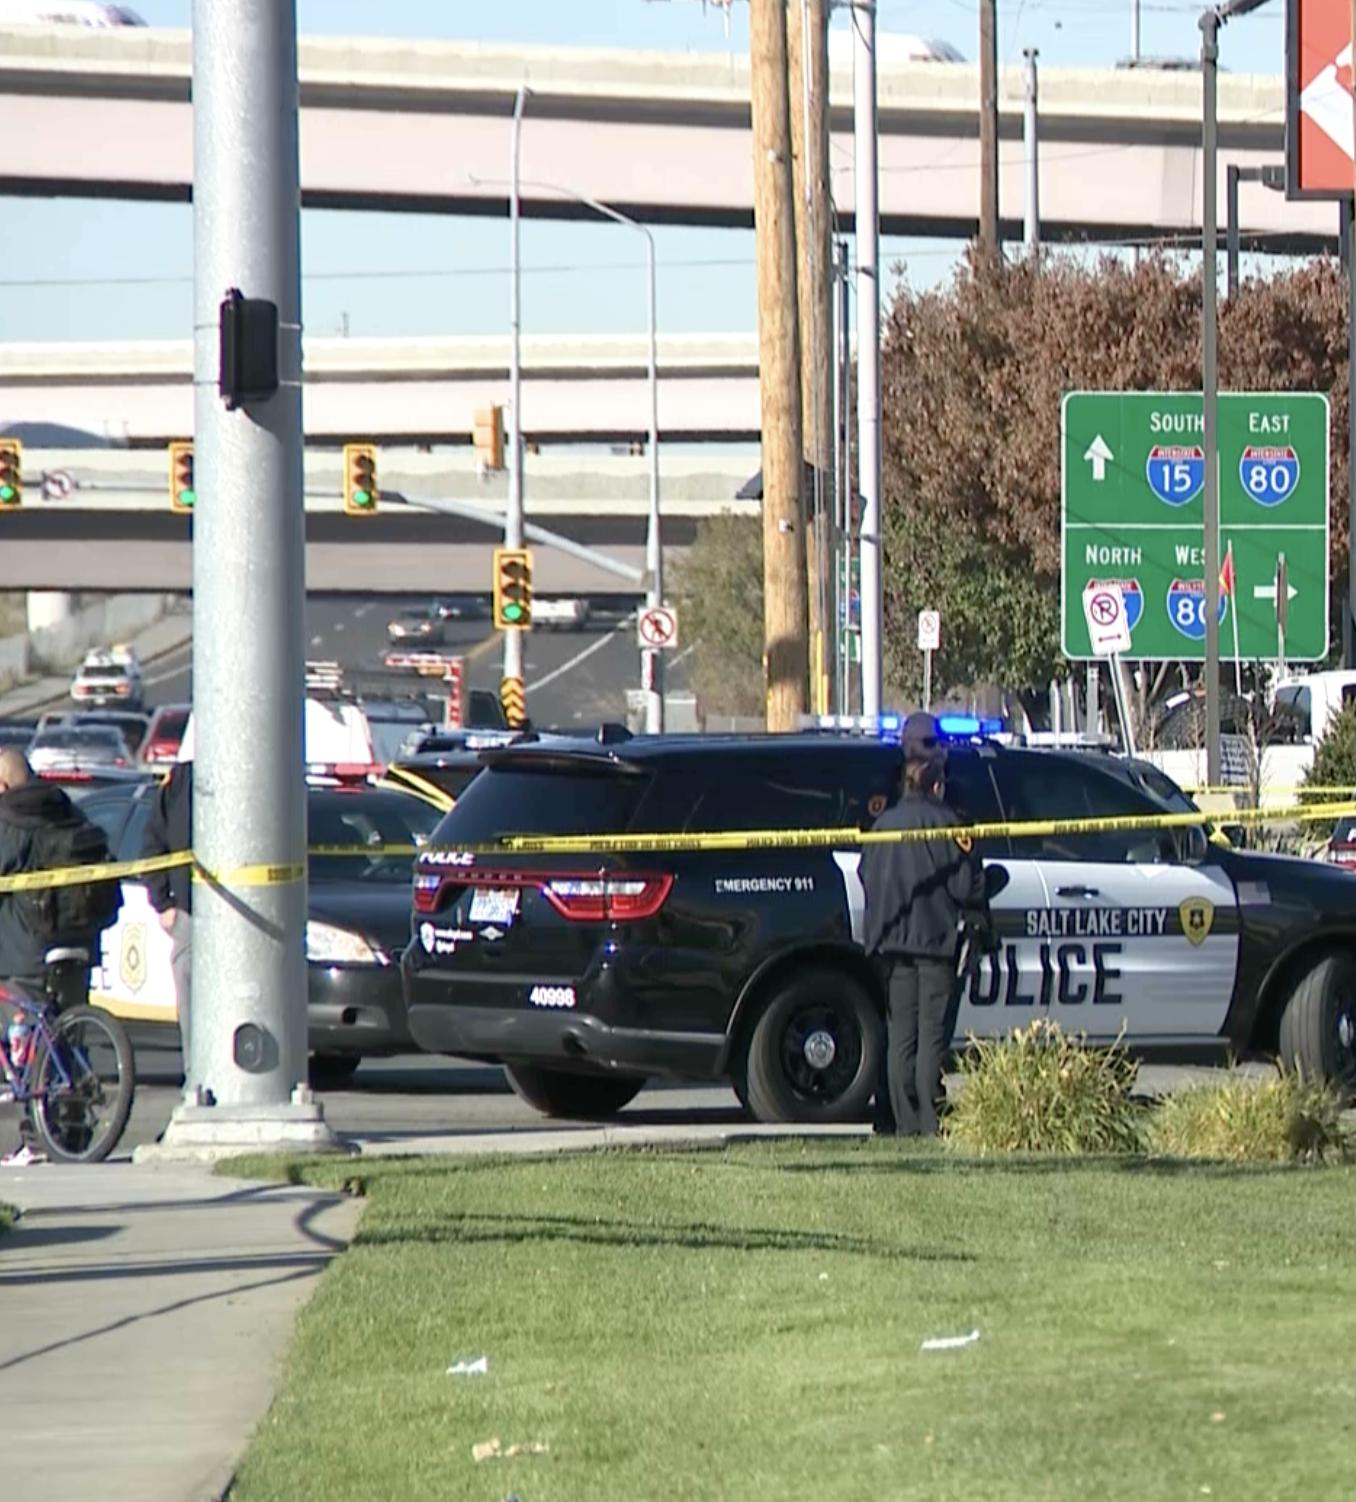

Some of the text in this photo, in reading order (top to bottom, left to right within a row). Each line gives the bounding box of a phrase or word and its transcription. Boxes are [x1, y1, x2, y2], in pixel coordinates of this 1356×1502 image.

[1150, 411, 1290, 433] SOUTH EAST
[1162, 464, 1191, 493] 15
[1250, 465, 1290, 494] 80
[1086, 543, 1205, 566] NORTH WES
[715, 876, 814, 893] EMERGENCY 911
[1027, 908, 1168, 935] SALT LAKE CITY
[969, 943, 1123, 1006] OLICE
[529, 985, 576, 1008] 40998
